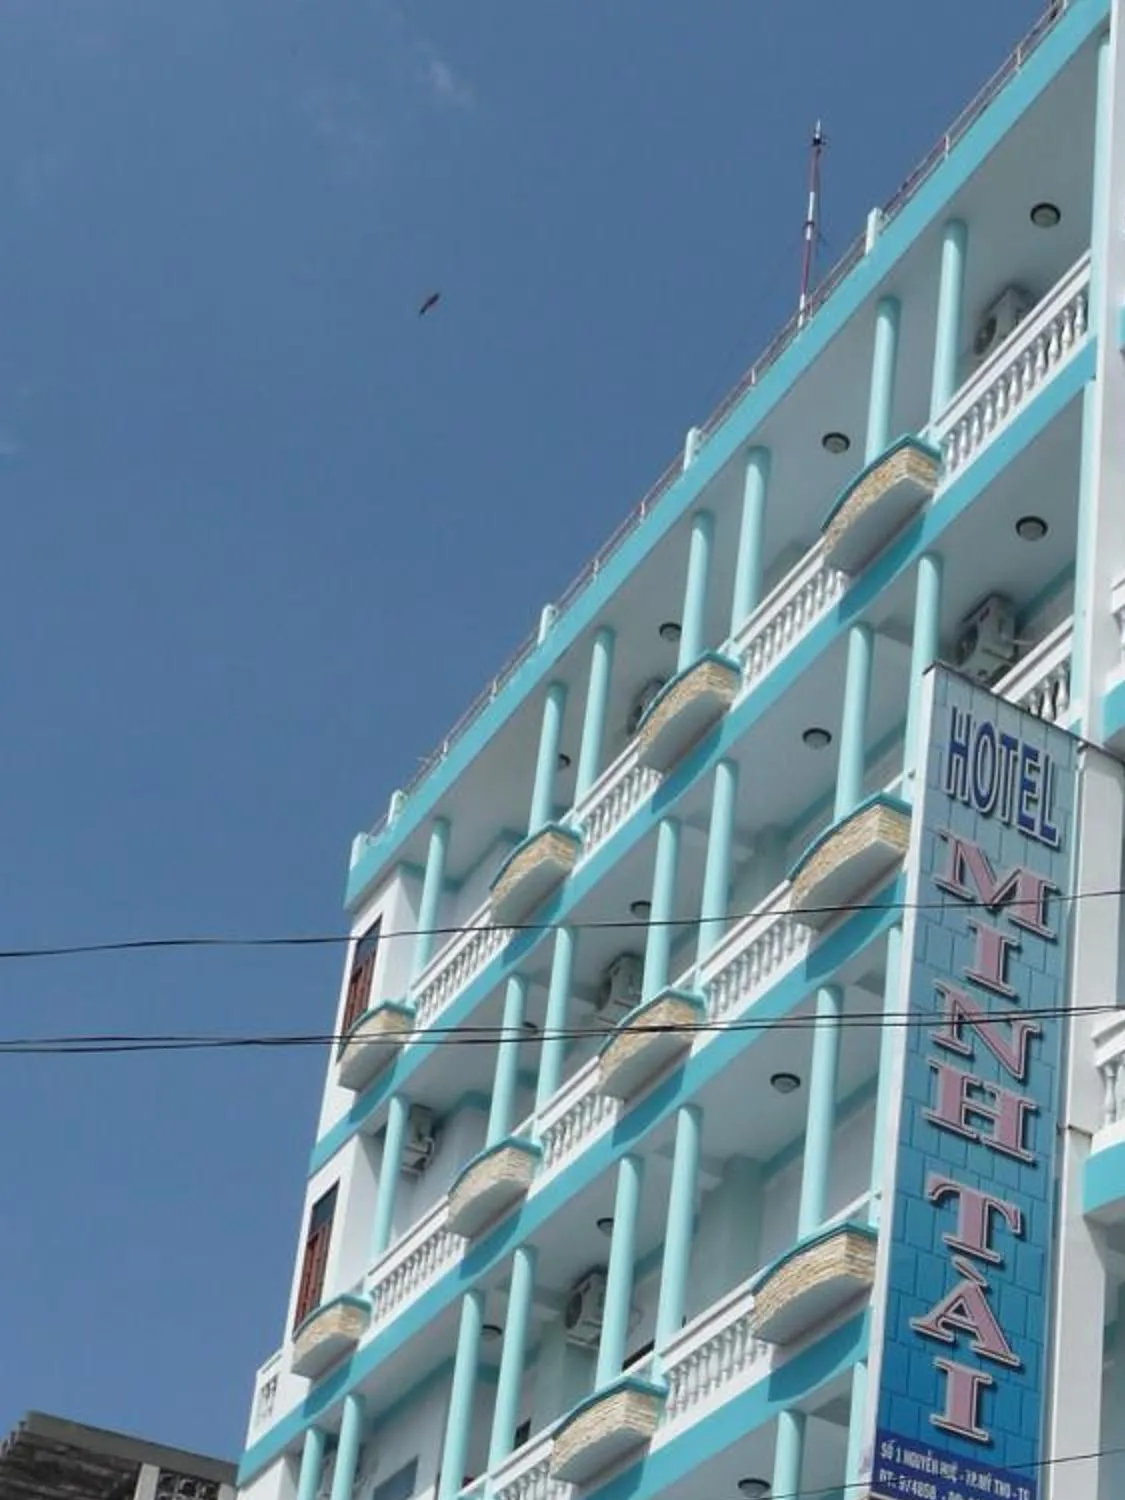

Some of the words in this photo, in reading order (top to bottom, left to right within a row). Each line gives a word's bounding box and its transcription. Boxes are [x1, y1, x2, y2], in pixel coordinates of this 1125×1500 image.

[943, 705, 1061, 848] HOTEL
[921, 826, 1059, 1163] MINH
[908, 1171, 1023, 1442] TÀI
